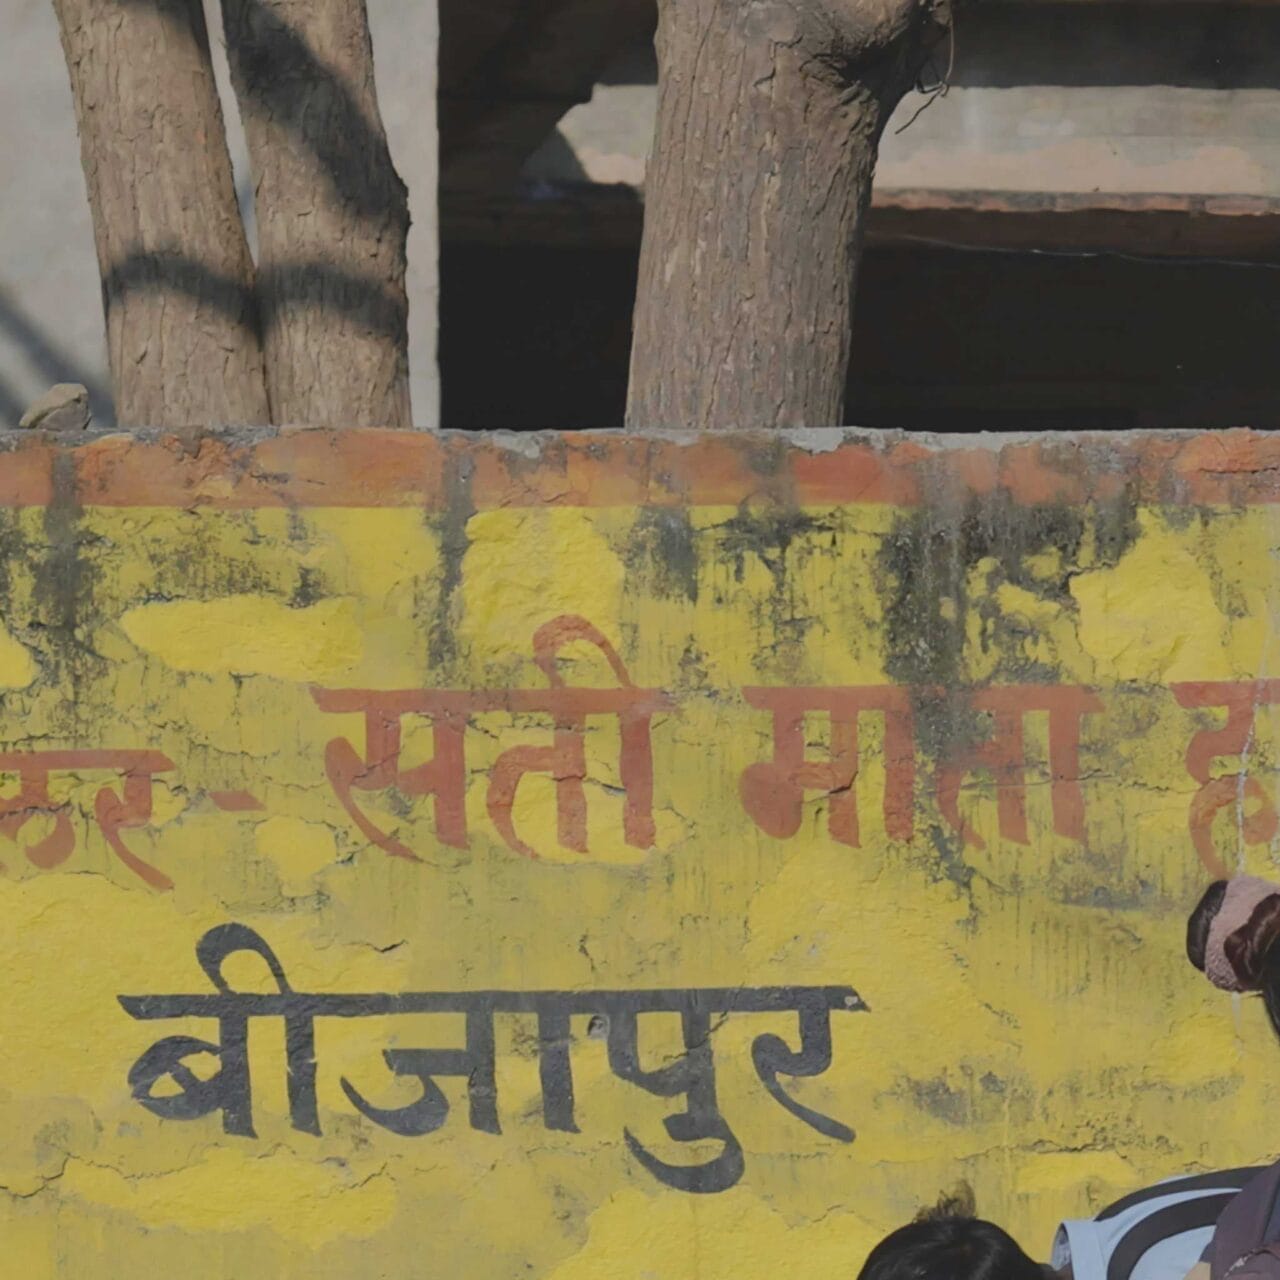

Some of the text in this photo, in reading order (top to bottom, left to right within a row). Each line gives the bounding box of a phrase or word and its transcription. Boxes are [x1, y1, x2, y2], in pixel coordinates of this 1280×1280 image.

[309, 614, 676, 863] सती
[738, 683, 1106, 850] माता
[116, 921, 873, 1194] बीजापुर
